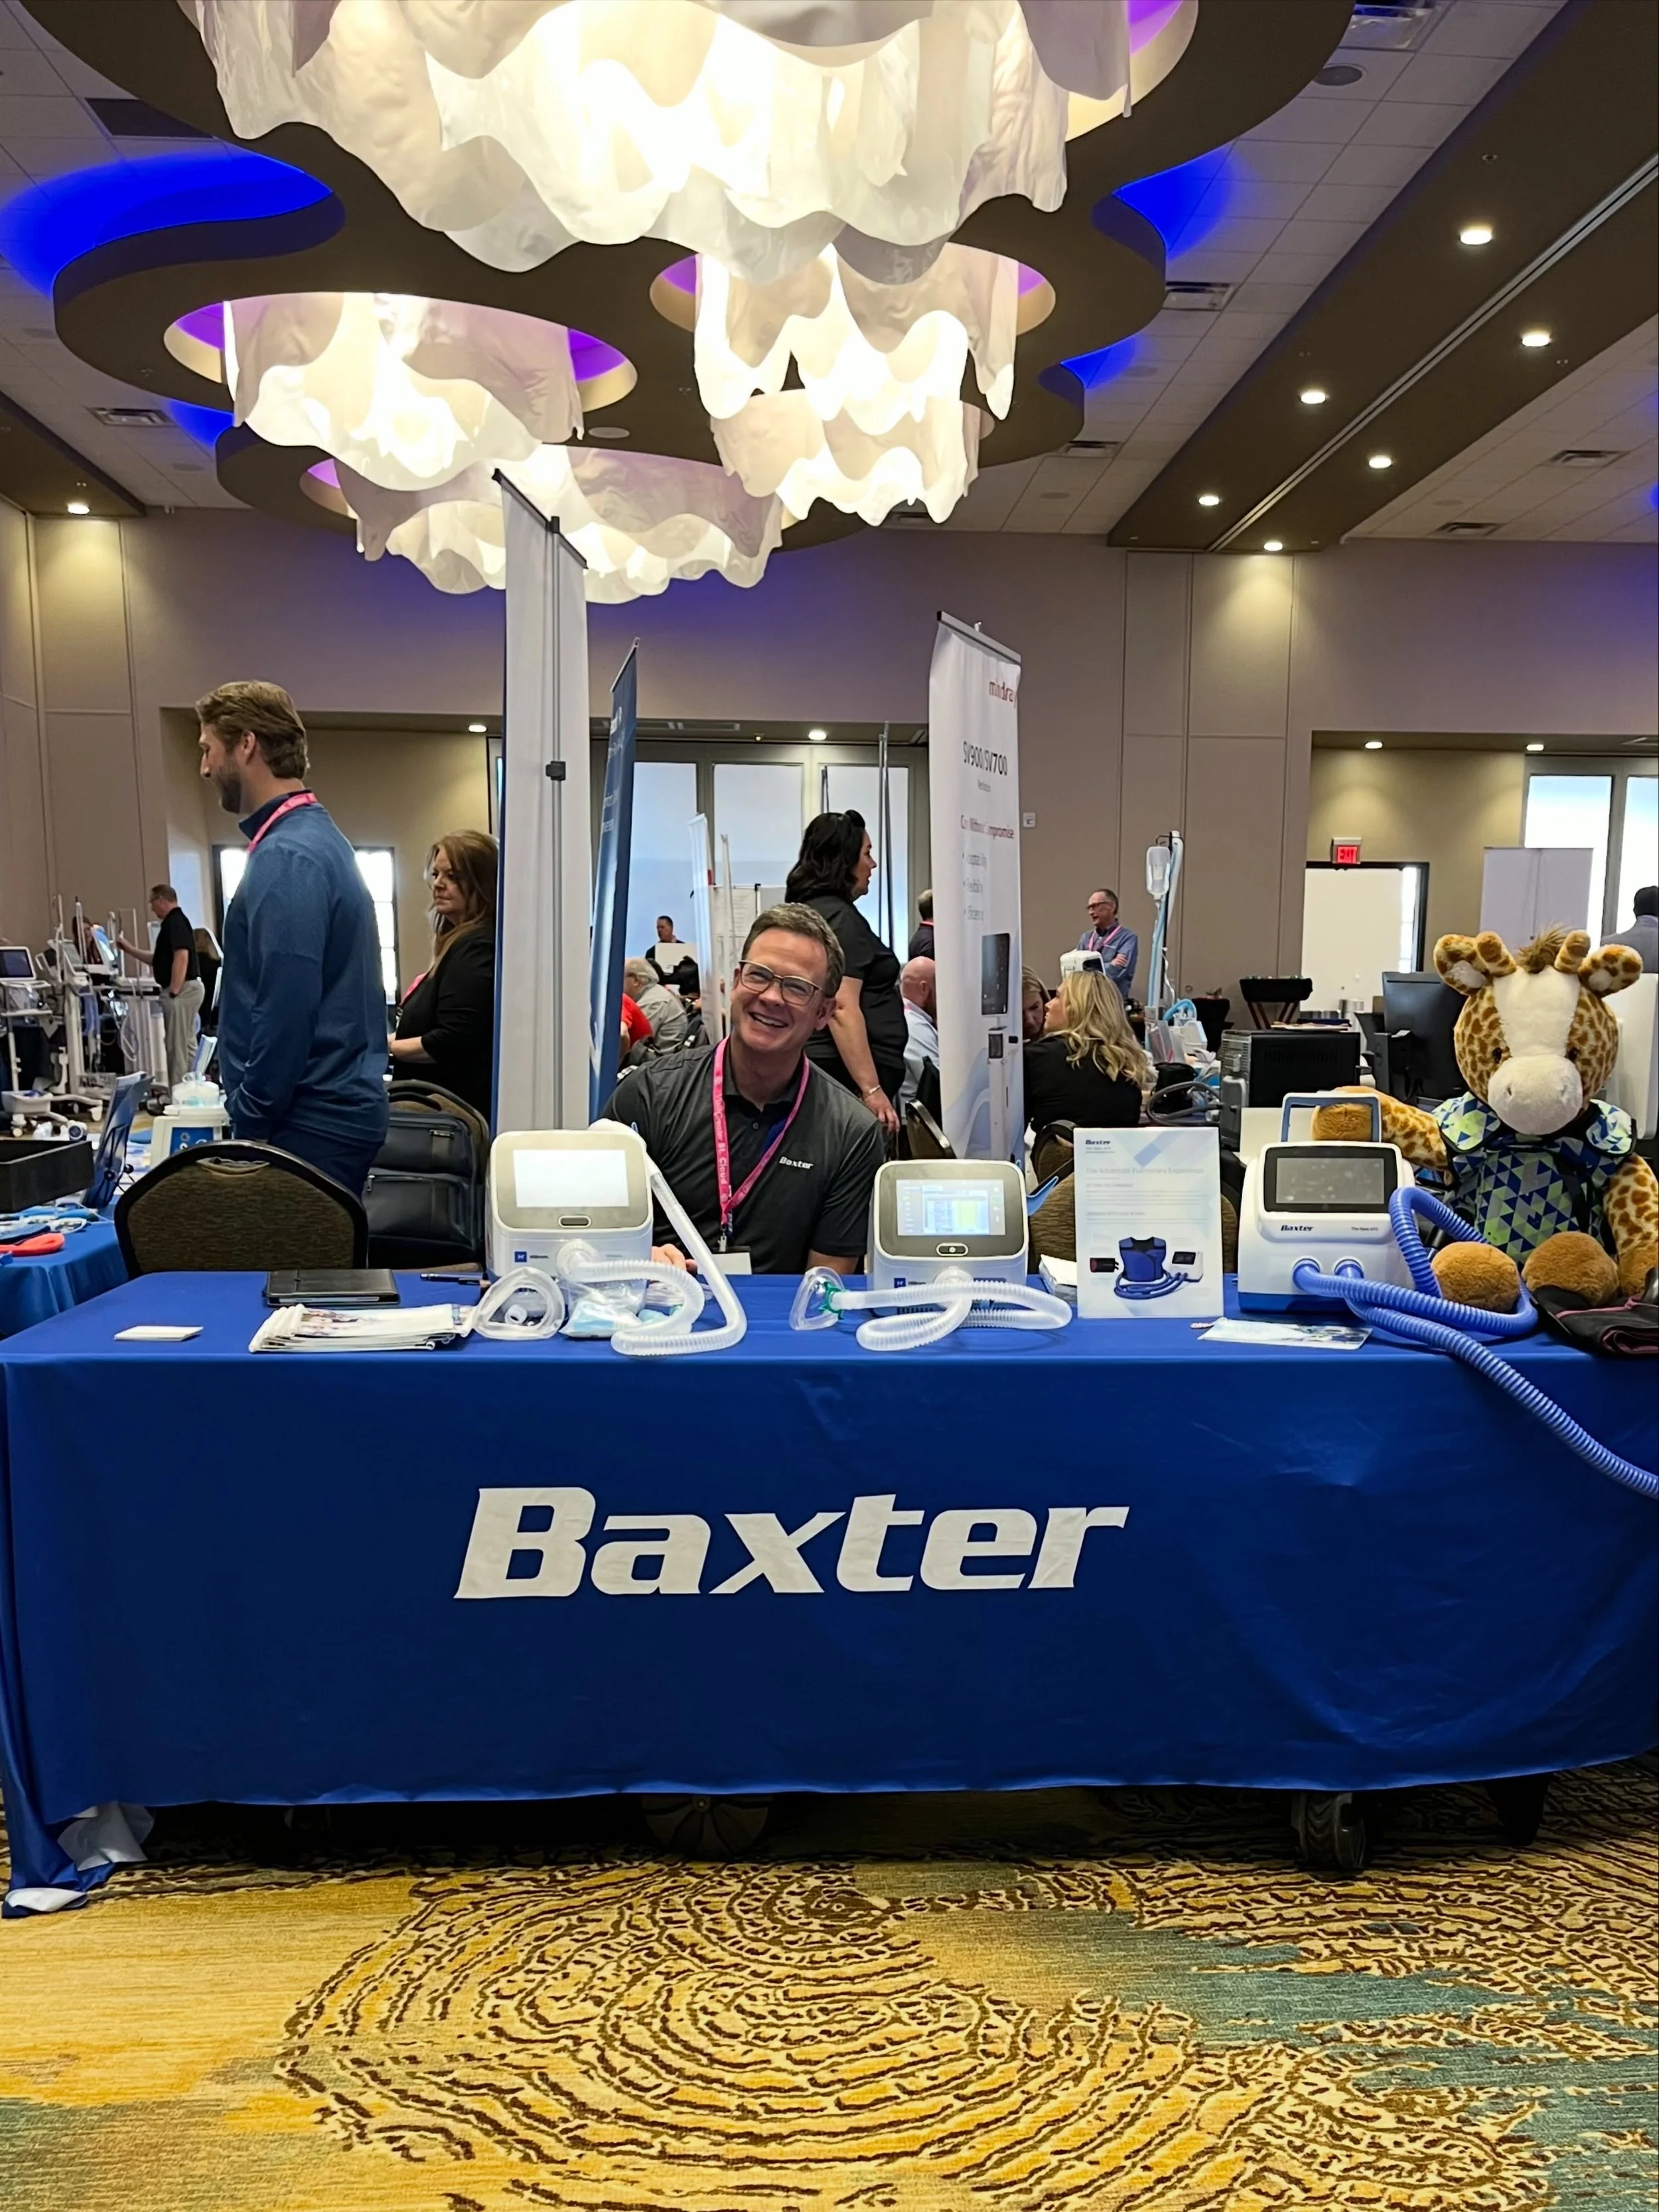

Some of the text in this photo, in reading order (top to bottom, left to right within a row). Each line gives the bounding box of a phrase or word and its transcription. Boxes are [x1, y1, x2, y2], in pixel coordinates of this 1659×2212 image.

[719, 1157, 728, 1185] Cloud
[779, 1156, 814, 1169] Baxter
[453, 1487, 1129, 1599] Baxter
